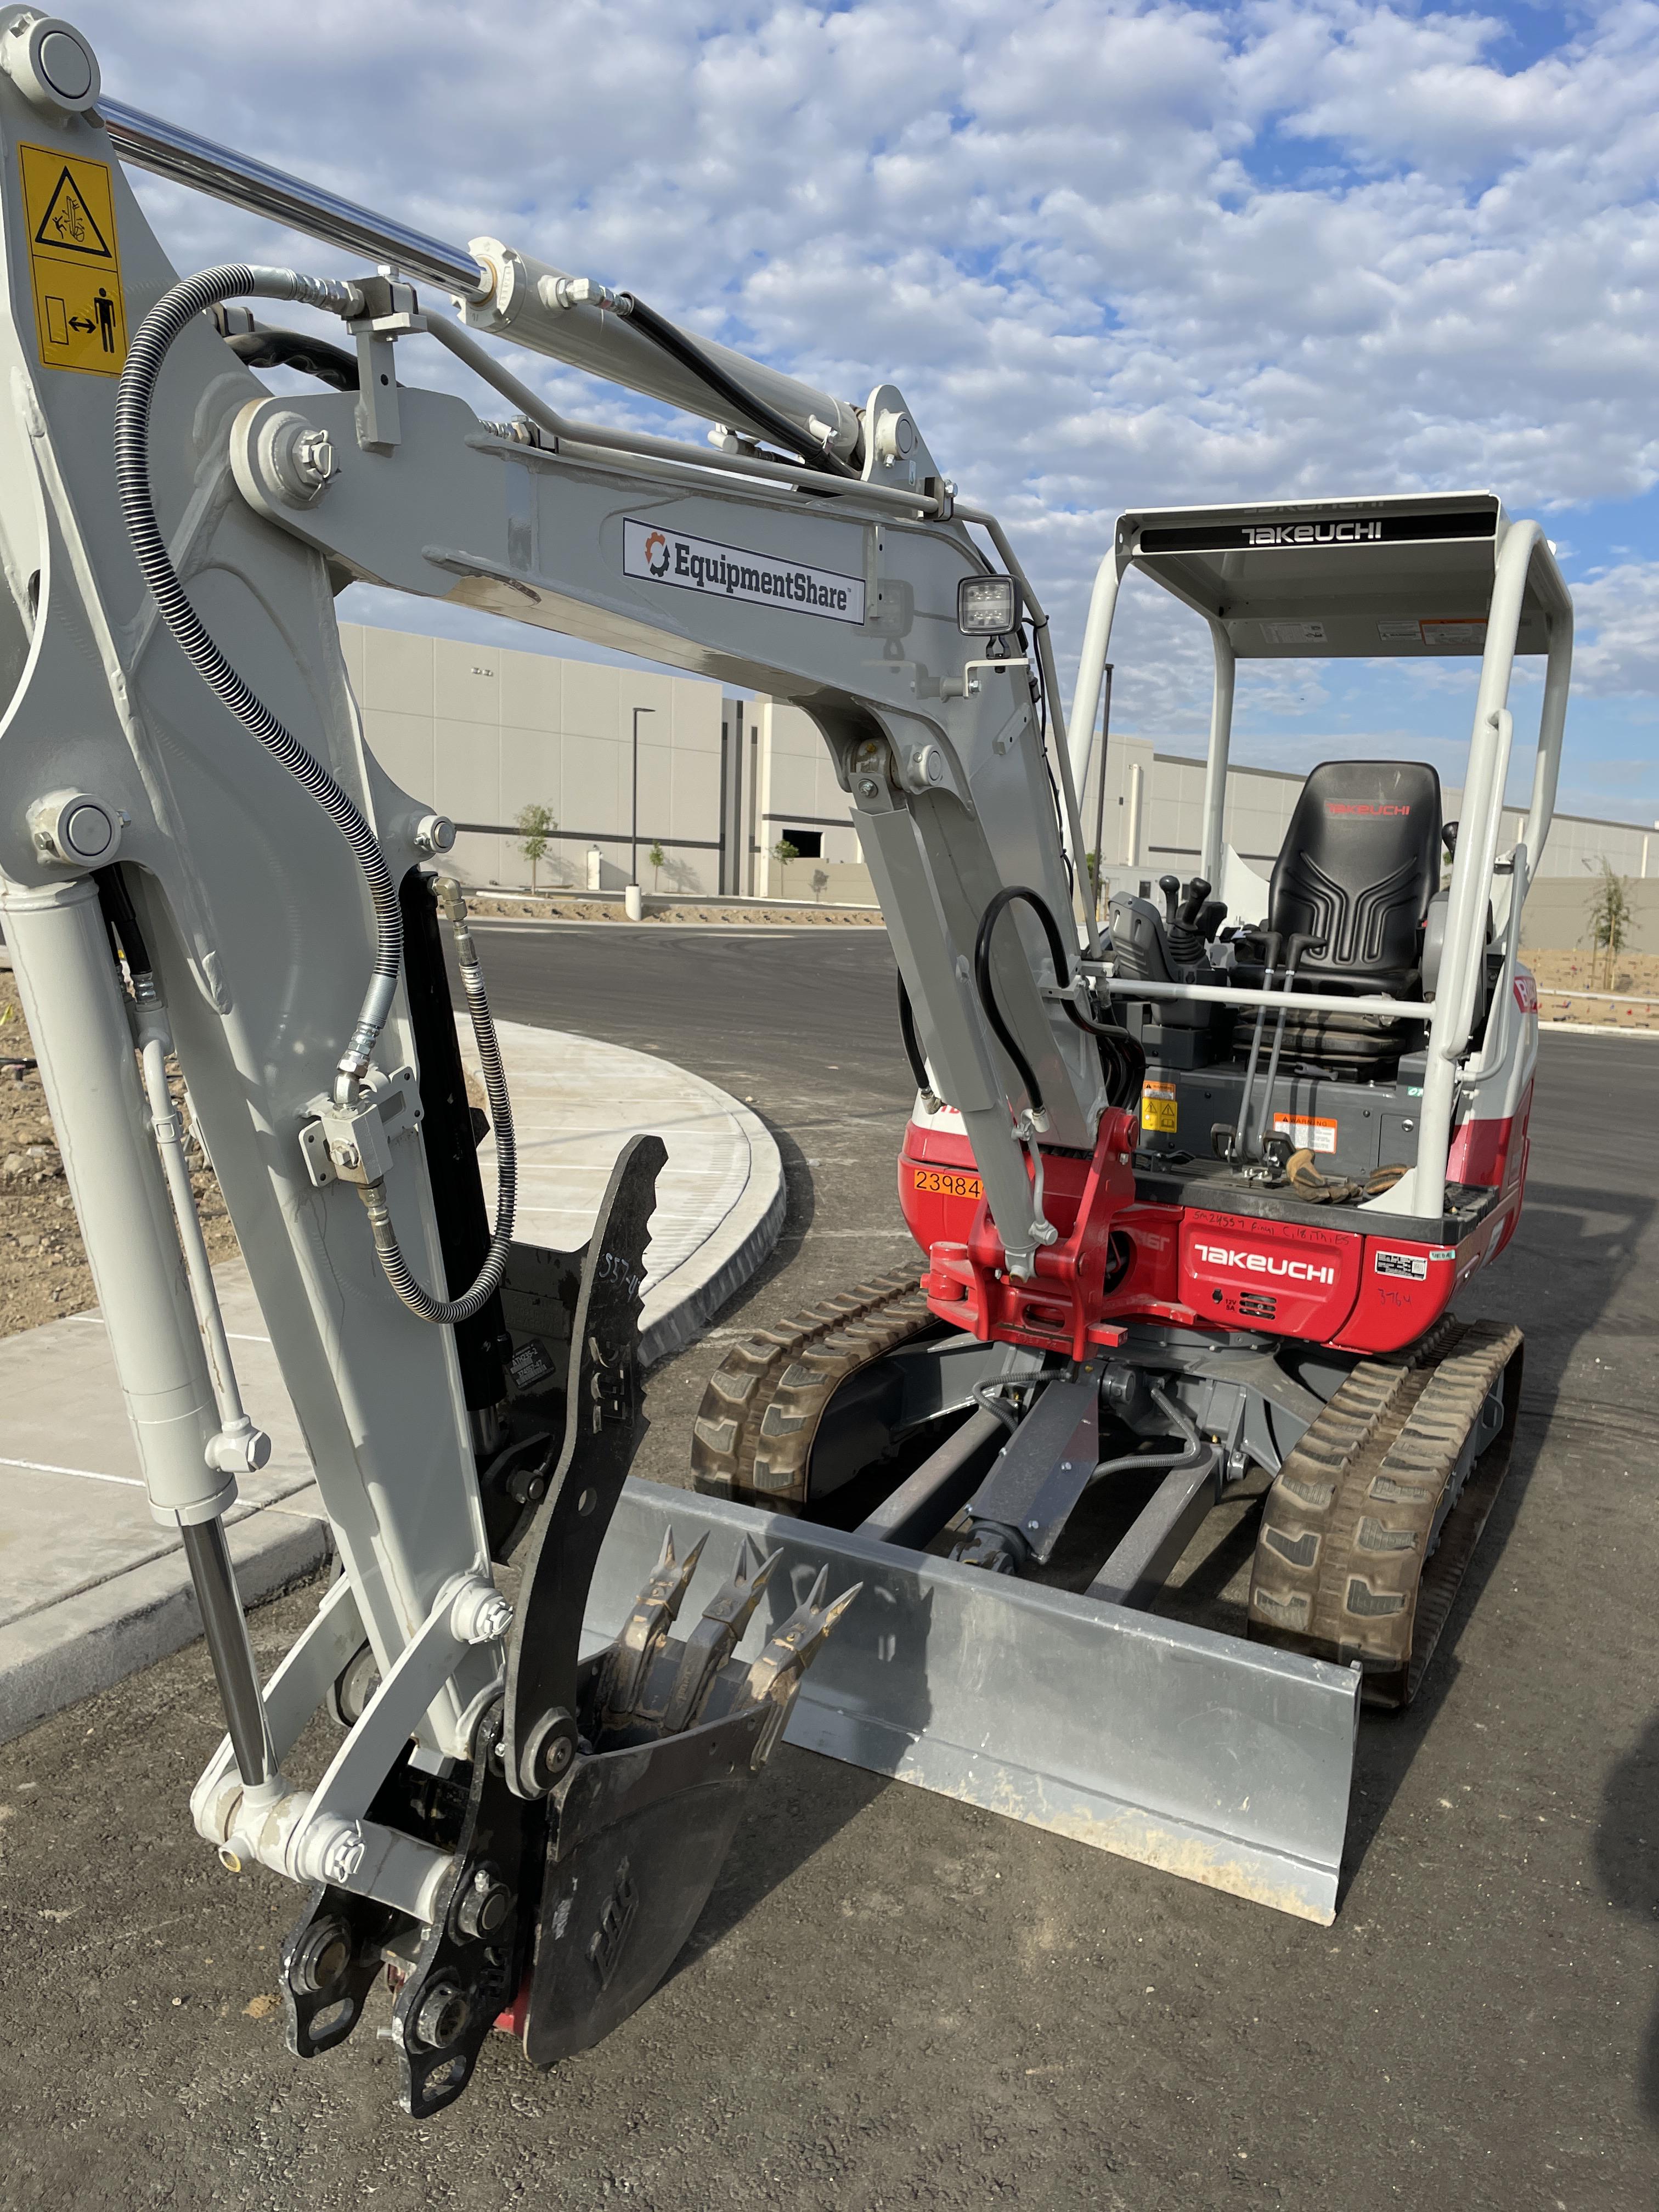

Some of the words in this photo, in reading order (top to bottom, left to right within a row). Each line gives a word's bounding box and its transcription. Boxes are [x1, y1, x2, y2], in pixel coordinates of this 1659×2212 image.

[1242, 521, 1381, 545] TAKEUCHI
[675, 543, 847, 611] EquipmentShare
[1325, 803, 1410, 816] TAKEUCHI
[1290, 1117, 1327, 1127] WARNING
[916, 1171, 983, 1198] 23984
[1194, 1244, 1334, 1285] TAKEUCHI
